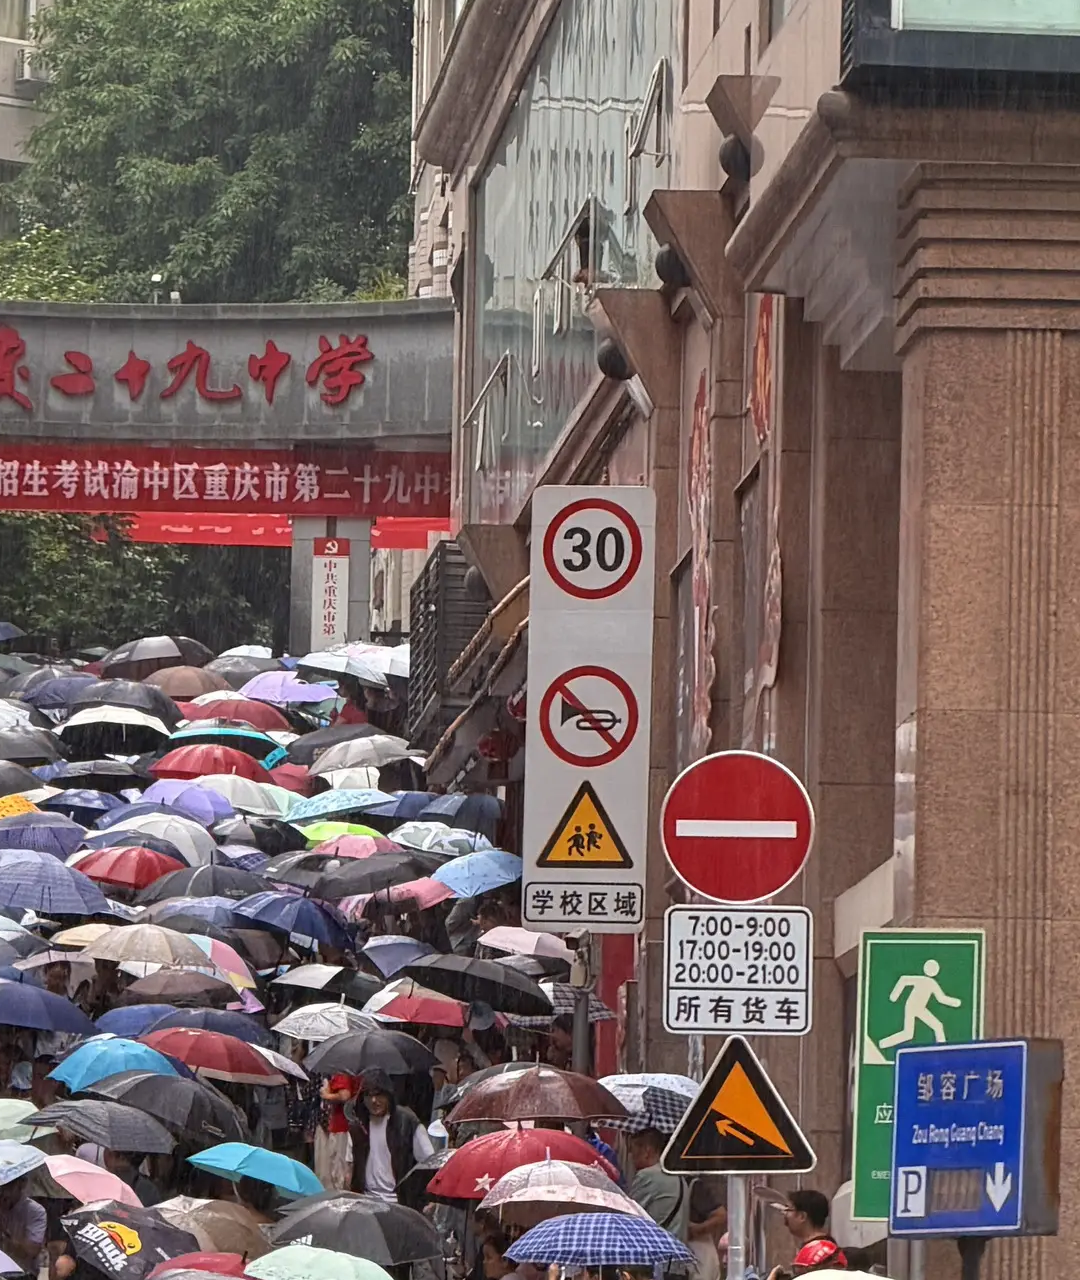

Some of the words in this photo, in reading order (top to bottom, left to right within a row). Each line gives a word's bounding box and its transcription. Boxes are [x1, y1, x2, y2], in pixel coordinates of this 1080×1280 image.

[562, 526, 625, 573] 30
[322, 559, 338, 641] 中共重庆市第
[531, 888, 637, 921] 学校区域
[687, 915, 791, 938] 7:00-9:00
[678, 939, 796, 962] 17:00-19:00
[674, 962, 800, 985] 20:00-21:00
[674, 995, 800, 1025] 所有货车
[917, 1069, 1004, 1101] 邹容广场
[874, 1102, 894, 1124] 应
[912, 1124, 928, 1144] Zou
[929, 1123, 950, 1148] Rong
[978, 1121, 1005, 1145] Chang
[901, 1170, 923, 1214] P
